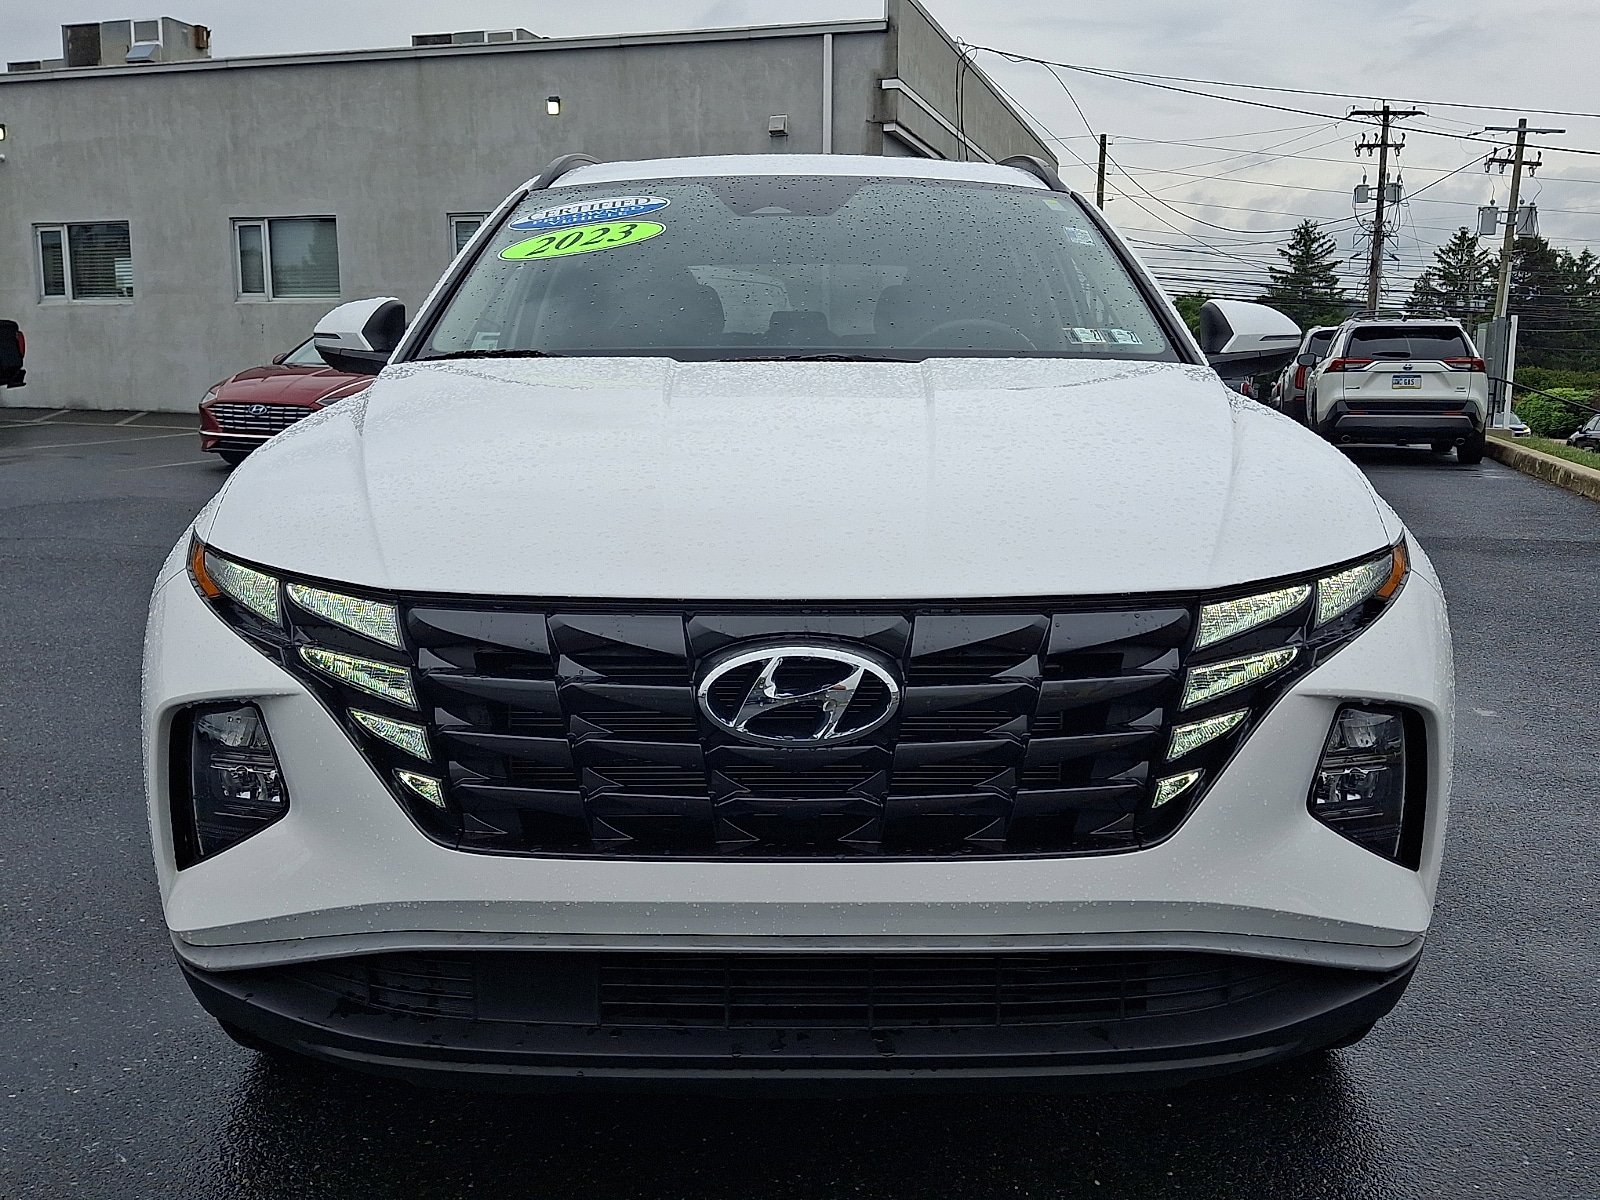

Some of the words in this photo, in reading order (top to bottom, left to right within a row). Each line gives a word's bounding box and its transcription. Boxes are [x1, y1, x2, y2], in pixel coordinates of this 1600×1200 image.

[528, 197, 651, 221] CERTIFIED
[549, 211, 629, 226] VEHICLE
[525, 223, 638, 257] 2023
